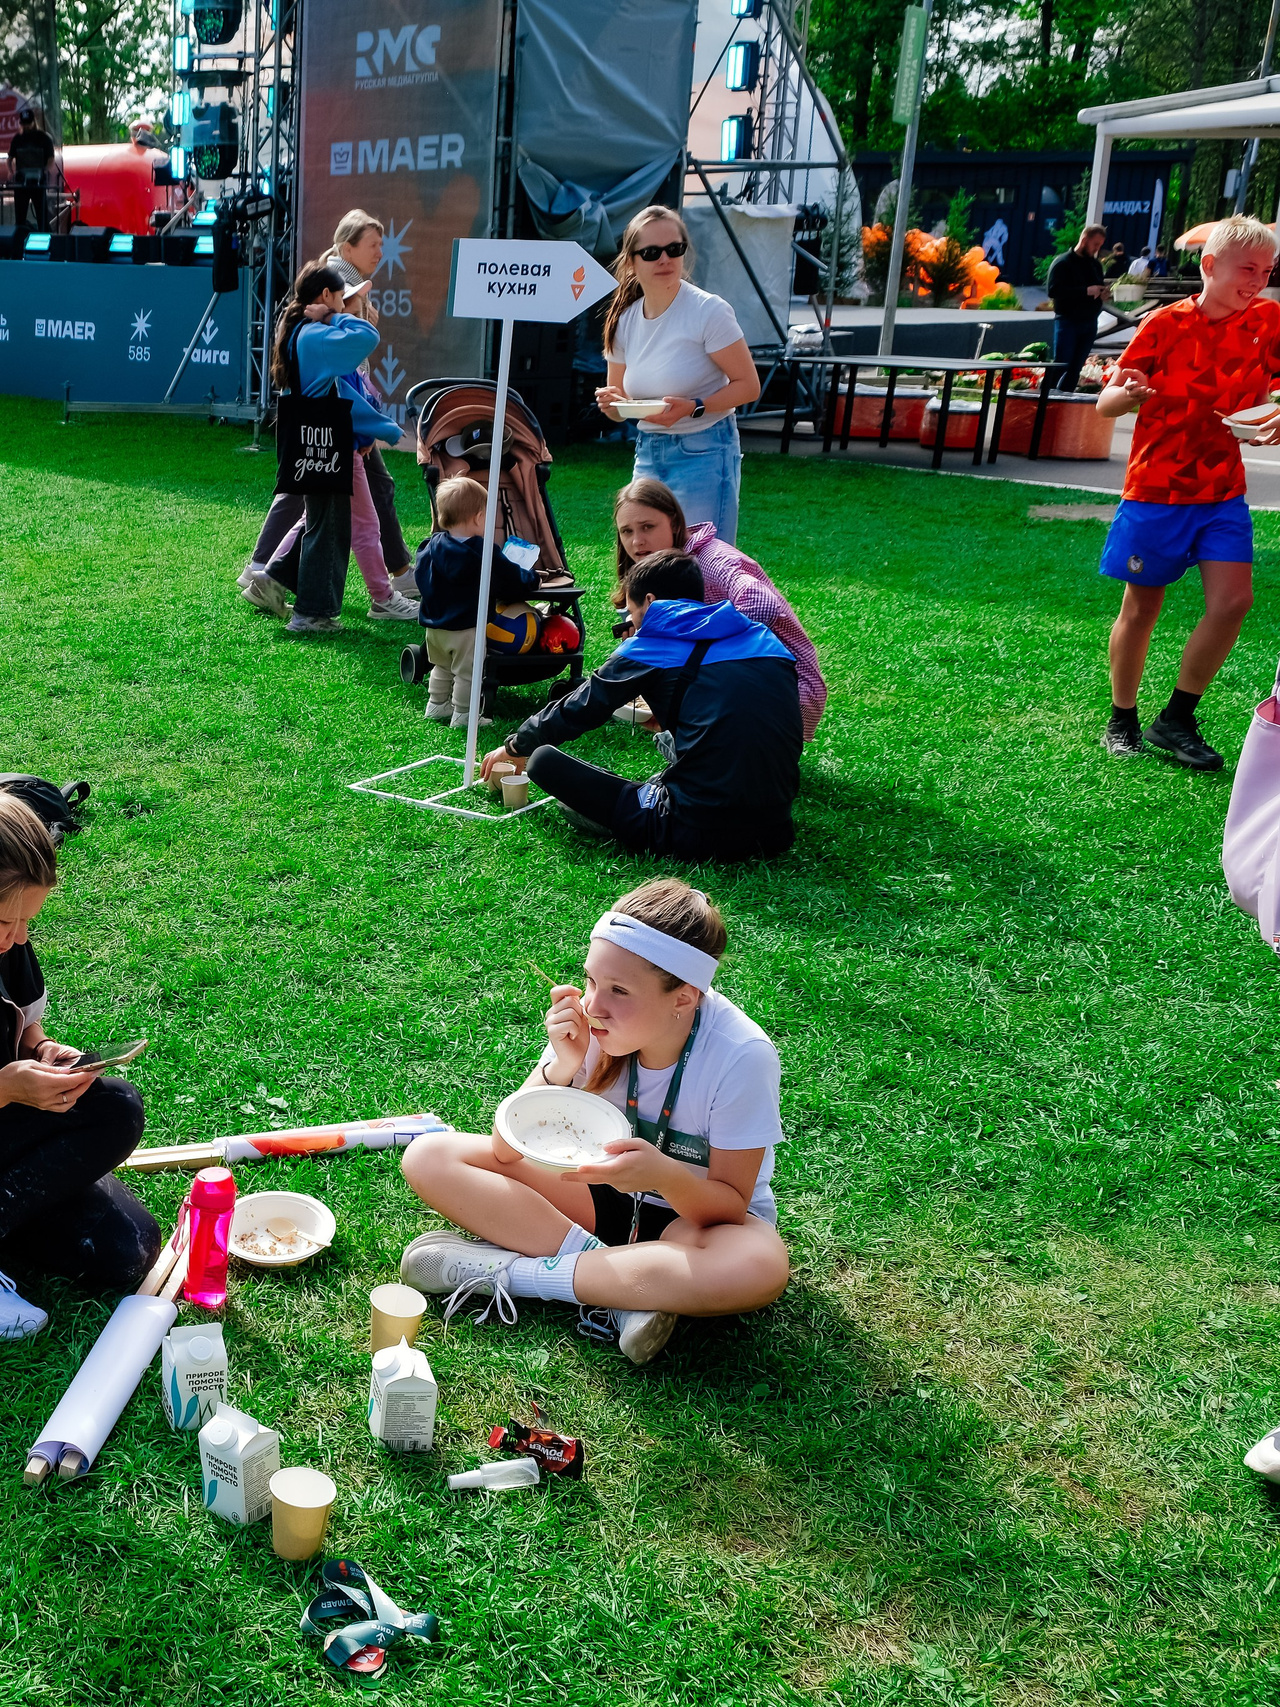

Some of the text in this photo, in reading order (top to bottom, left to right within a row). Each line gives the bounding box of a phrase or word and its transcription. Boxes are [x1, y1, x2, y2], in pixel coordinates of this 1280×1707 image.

[355, 71, 439, 91] РУССКАЯ МЕДИАГРУППА
[905, 59, 918, 116] СПОРТА
[358, 133, 465, 174] MAER
[1143, 201, 1151, 213] 2
[477, 262, 551, 277] полевая
[487, 281, 537, 298] кухня
[47, 320, 96, 341] MAER
[128, 345, 151, 361] 585
[301, 425, 333, 447] FOCUS
[305, 446, 328, 459] ON THE
[294, 452, 341, 481] good
[668, 1147, 702, 1160] ЖИЗНИ
[669, 1142, 699, 1154] ОГОНЬ
[188, 1377, 225, 1386] ПОМОЧЬ
[191, 1384, 225, 1393] ПРОСТО
[528, 1443, 564, 1458] POWER
[208, 1461, 238, 1481] ПОМОЧЬ
[210, 1469, 239, 1488] ПРОСТО
[321, 1599, 347, 1609] MAER
